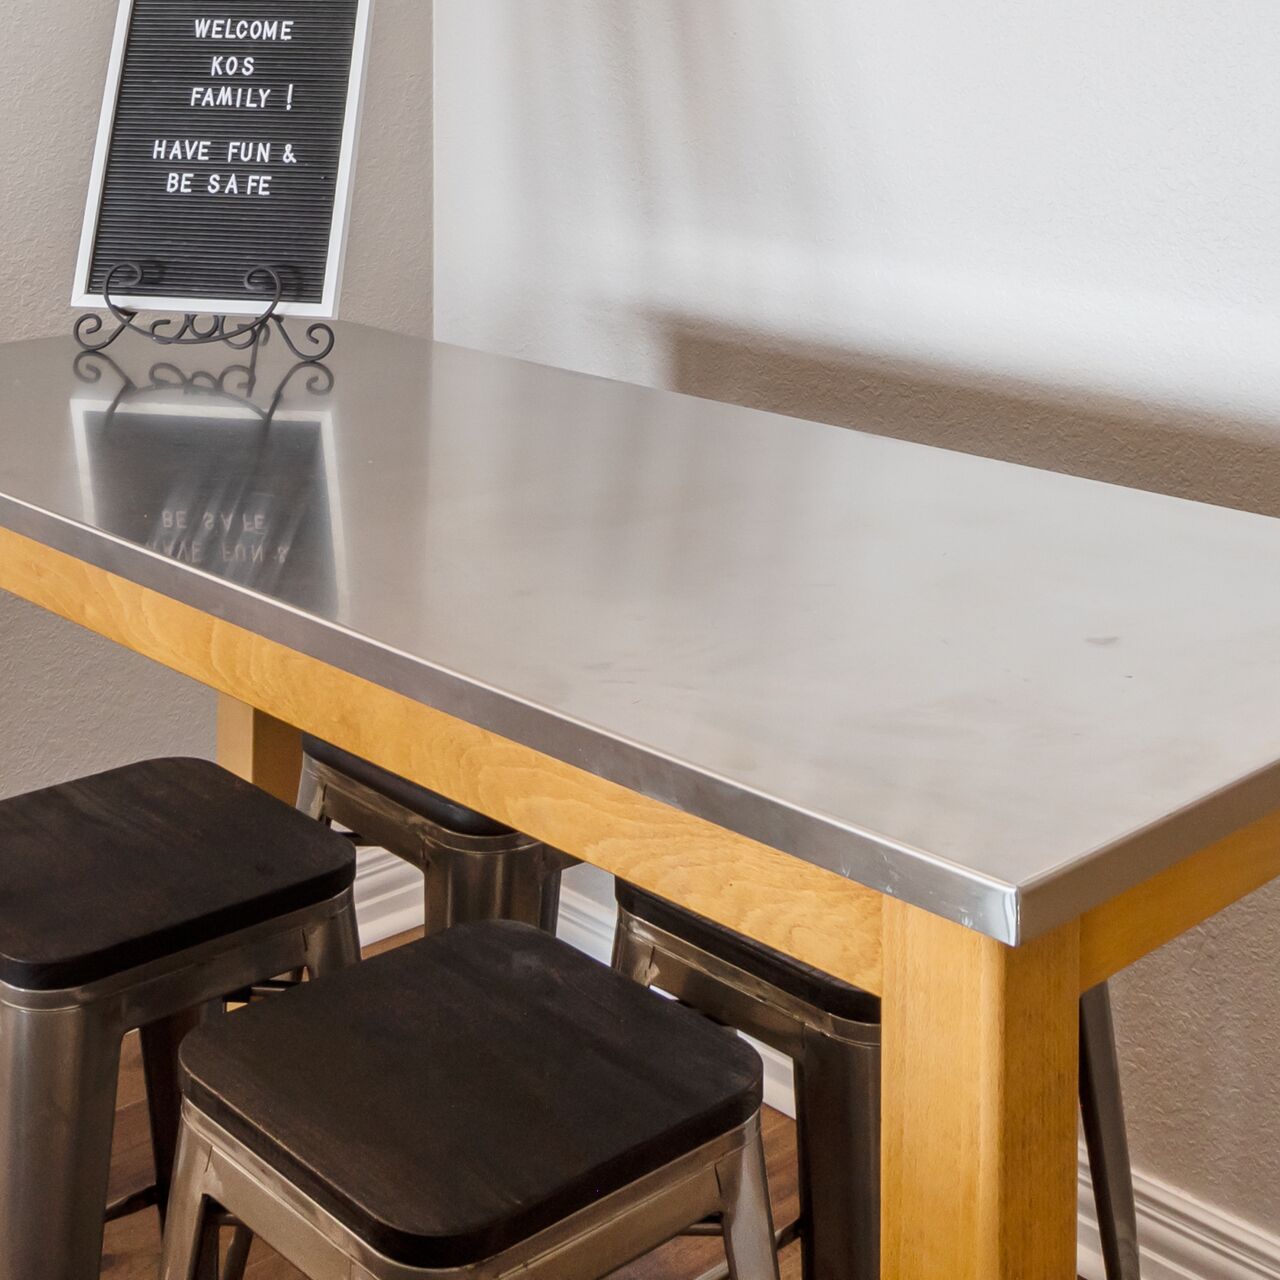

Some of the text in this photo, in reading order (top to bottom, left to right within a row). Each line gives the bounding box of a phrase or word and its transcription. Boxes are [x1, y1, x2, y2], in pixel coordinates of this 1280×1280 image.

[194, 17, 294, 41] WELCOME
[210, 55, 255, 77] KOS
[190, 83, 294, 111] FAMILY !
[152, 139, 297, 164] HAVE FUN &
[166, 172, 272, 196] BE SAFE
